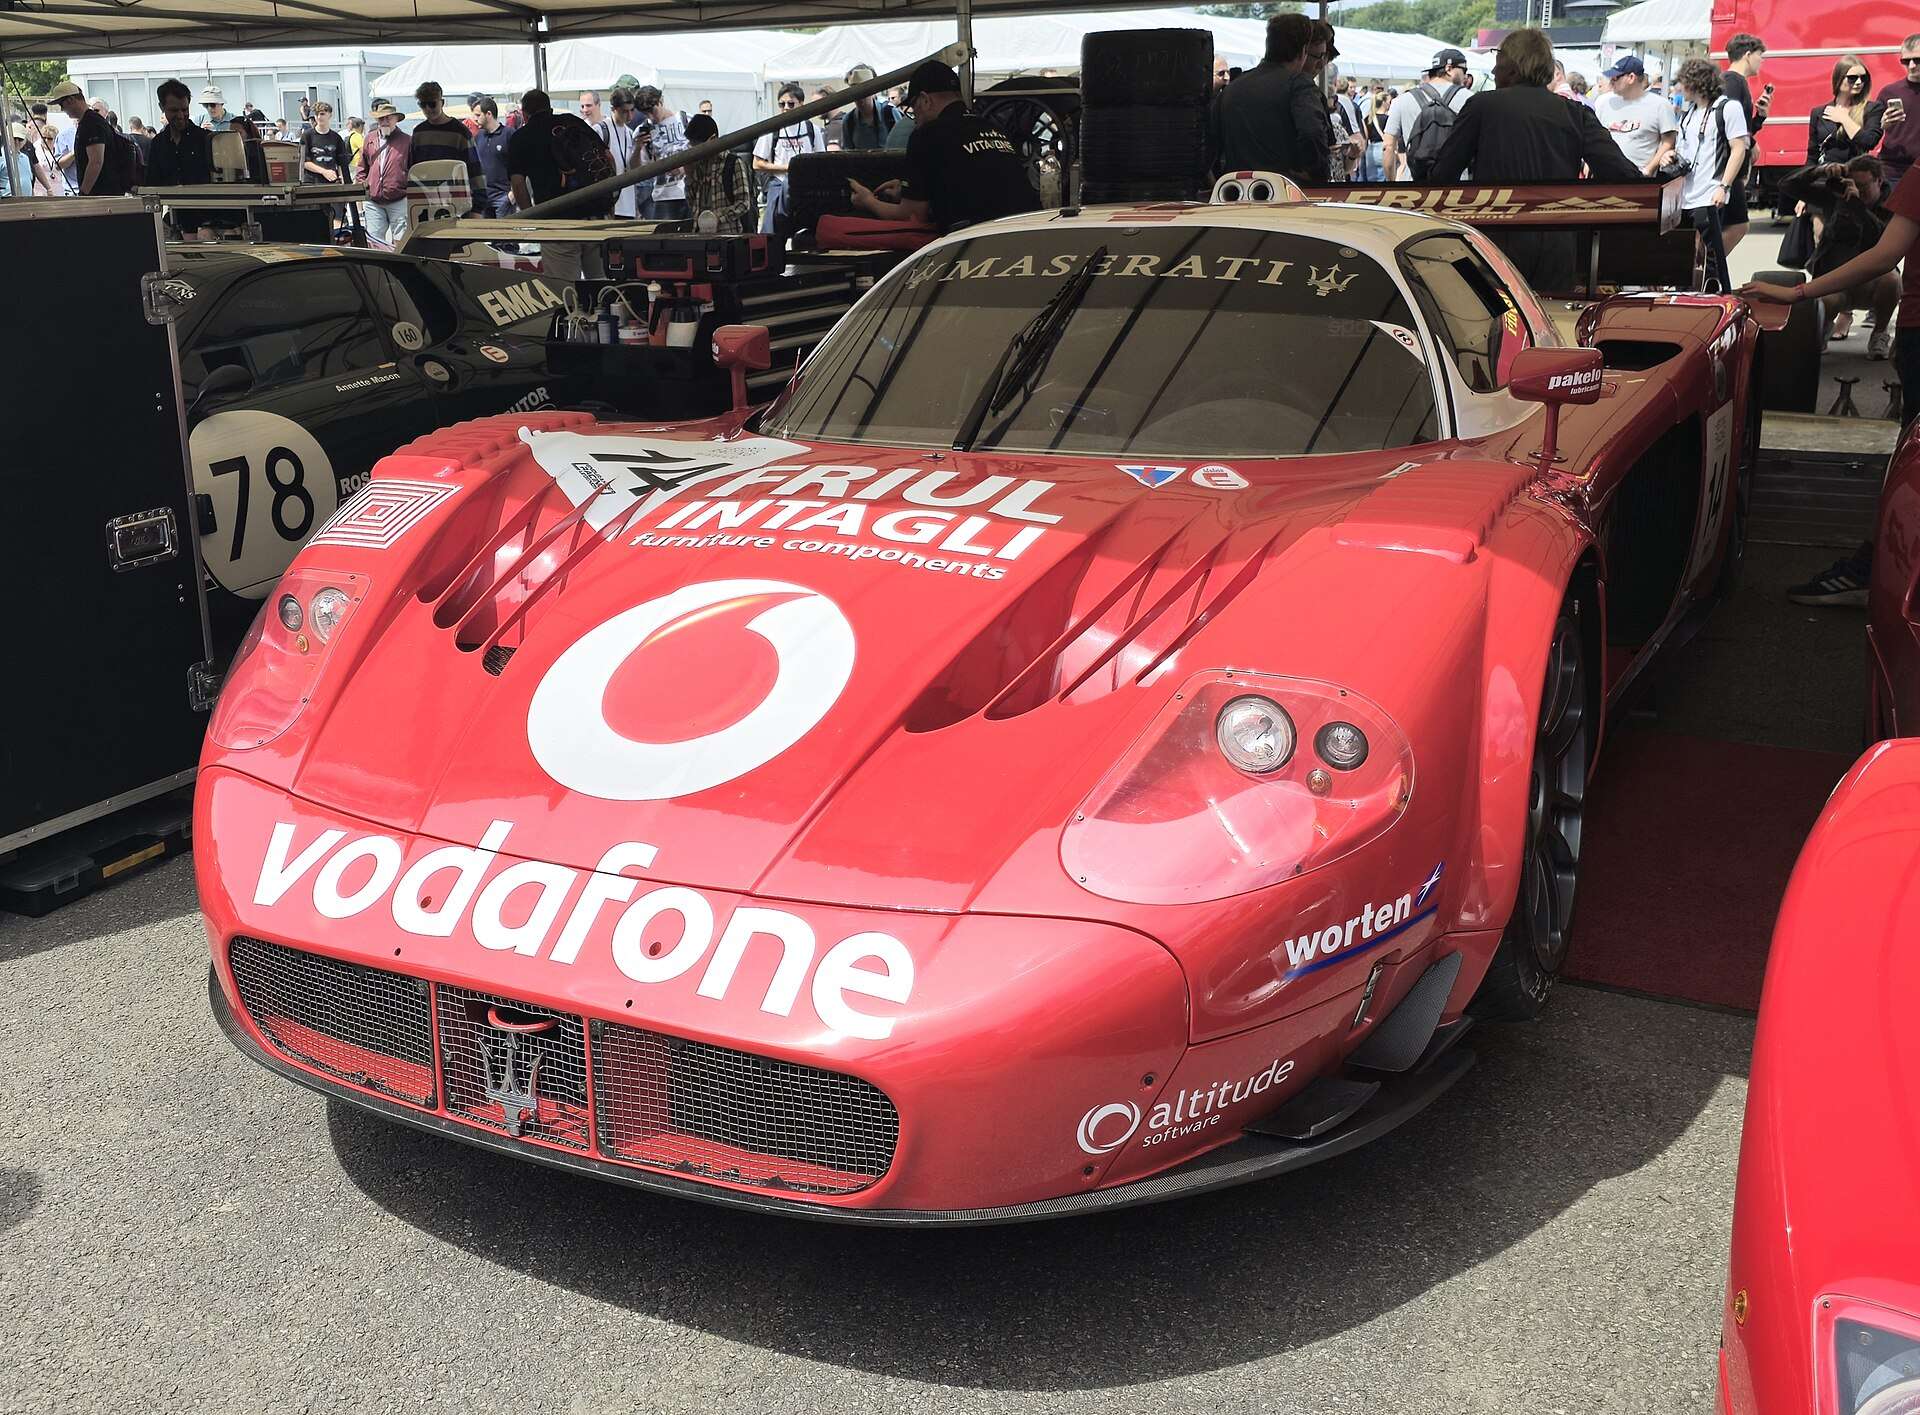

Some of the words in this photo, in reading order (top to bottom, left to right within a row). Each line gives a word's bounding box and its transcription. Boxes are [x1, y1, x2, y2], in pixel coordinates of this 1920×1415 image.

[1344, 189, 1528, 208] FRIUL
[938, 254, 1296, 286] MASERATI
[476, 277, 564, 327] EMKA
[397, 327, 418, 343] 160
[335, 377, 371, 393] Annette
[371, 372, 401, 386] Mason
[1547, 369, 1602, 390] pakelo
[208, 444, 315, 563] 78
[705, 463, 1065, 525] FRIUL
[655, 498, 1047, 561] INTAGLI
[627, 531, 777, 551] furniture
[780, 535, 1008, 581] components
[252, 819, 915, 1041] vodafone
[1284, 892, 1412, 966] worten
[1148, 1056, 1296, 1131] altitude
[1142, 1113, 1221, 1148] software
